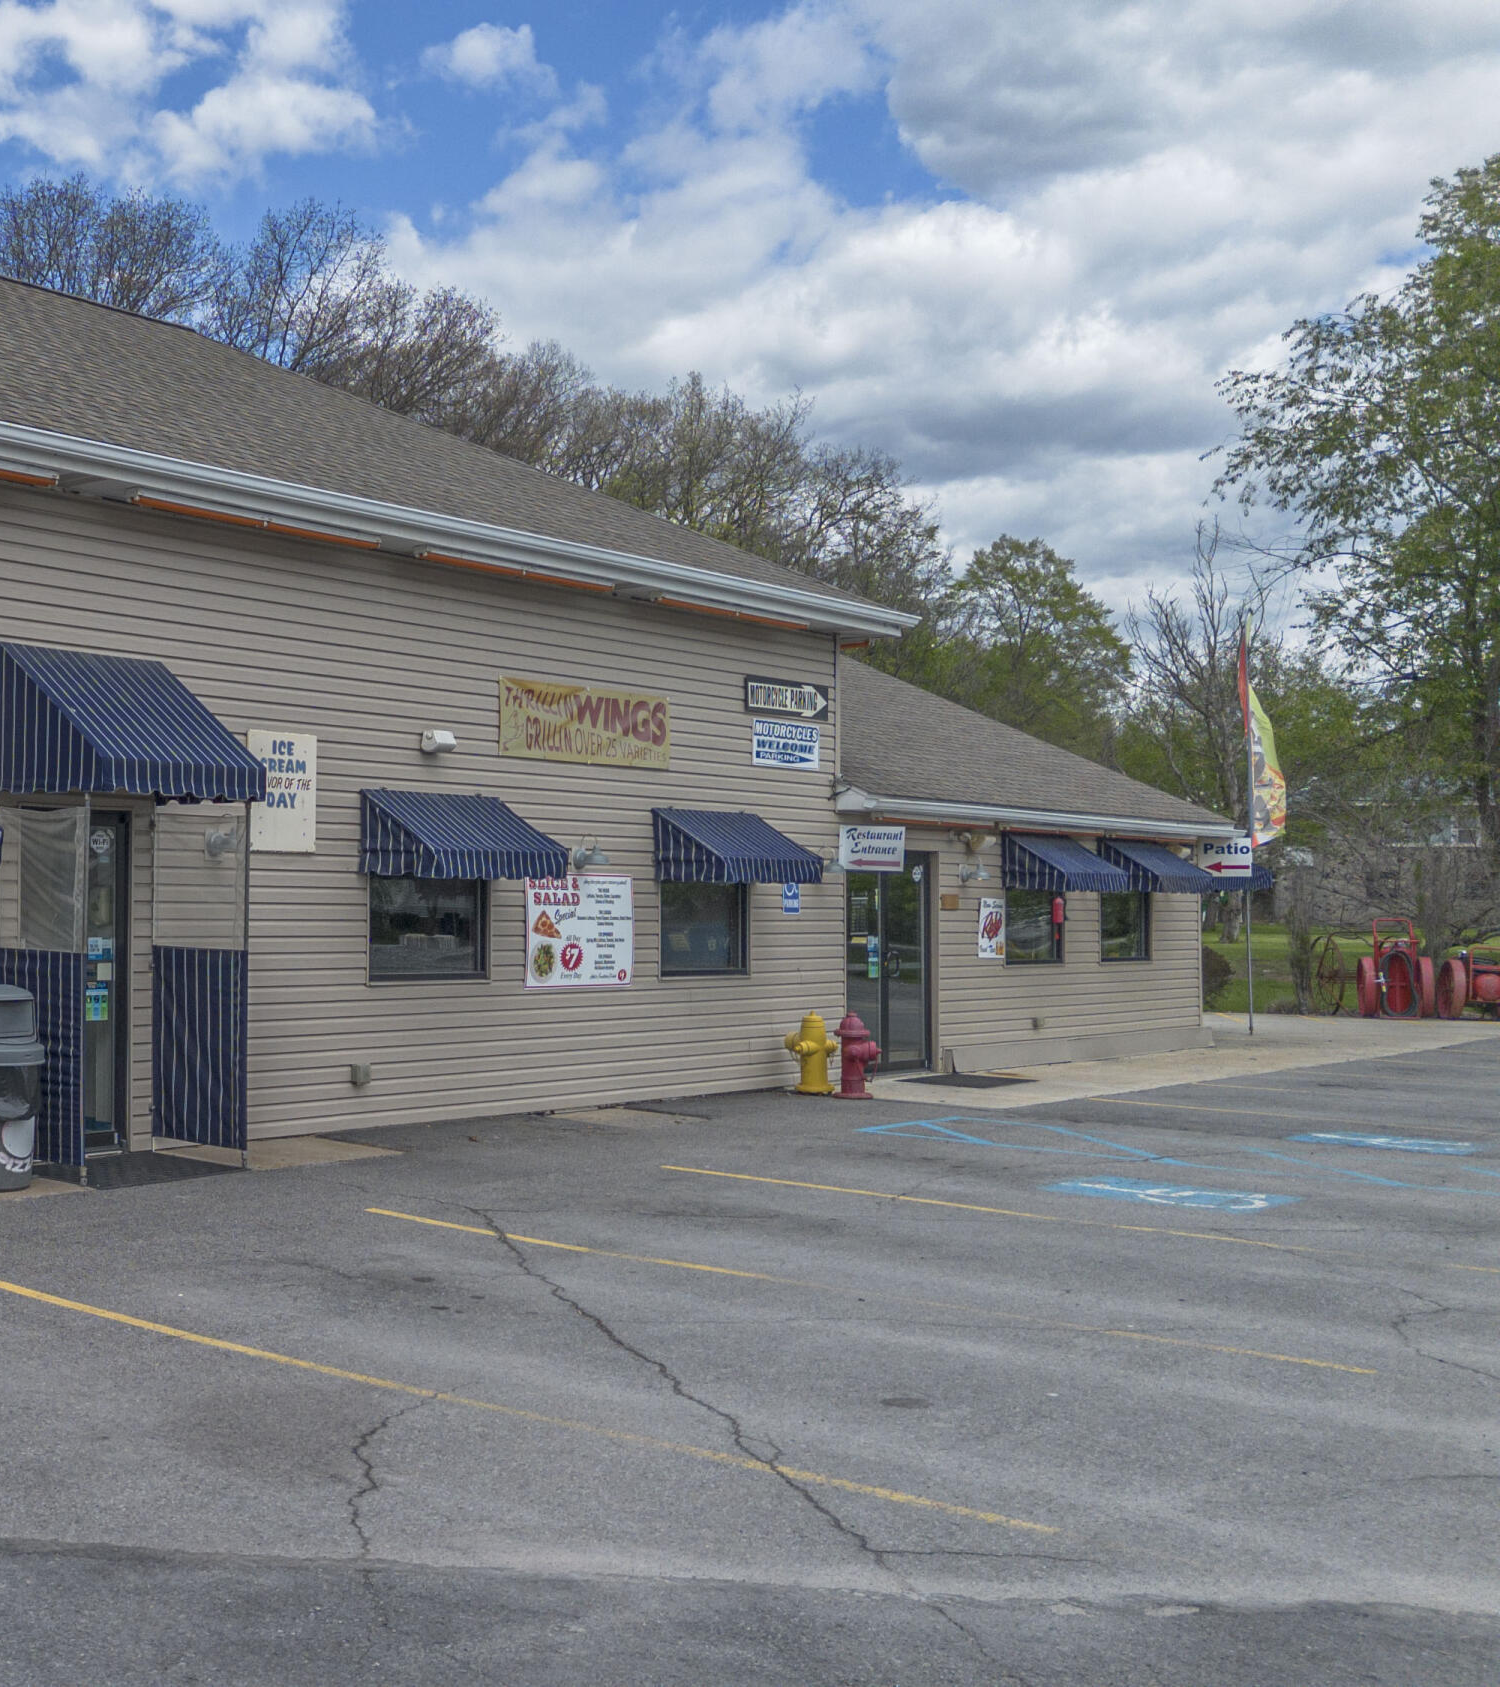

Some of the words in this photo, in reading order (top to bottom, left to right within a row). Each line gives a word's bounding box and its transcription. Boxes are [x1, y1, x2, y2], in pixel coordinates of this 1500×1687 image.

[750, 684, 788, 708] MOTORCYCLE
[790, 689, 818, 711] PARKING
[574, 694, 667, 747] WINGS
[525, 715, 572, 753] GRILLIN
[575, 728, 602, 756] OVER
[605, 737, 617, 758] 25
[619, 740, 667, 762] VARIETIES
[754, 720, 819, 743] MOTORCYCLES
[272, 739, 295, 756] ICE
[756, 738, 815, 754] WELCOME
[760, 751, 800, 763] PARKING
[284, 777, 295, 790] OF
[296, 778, 312, 790] THE
[266, 791, 297, 809] DAY
[845, 827, 903, 841] Restaurant
[850, 841, 897, 855] Entrance
[1203, 842, 1250, 855] Patio
[529, 876, 569, 890] SLICE
[571, 877, 580, 891] &
[533, 892, 580, 906] SALAD
